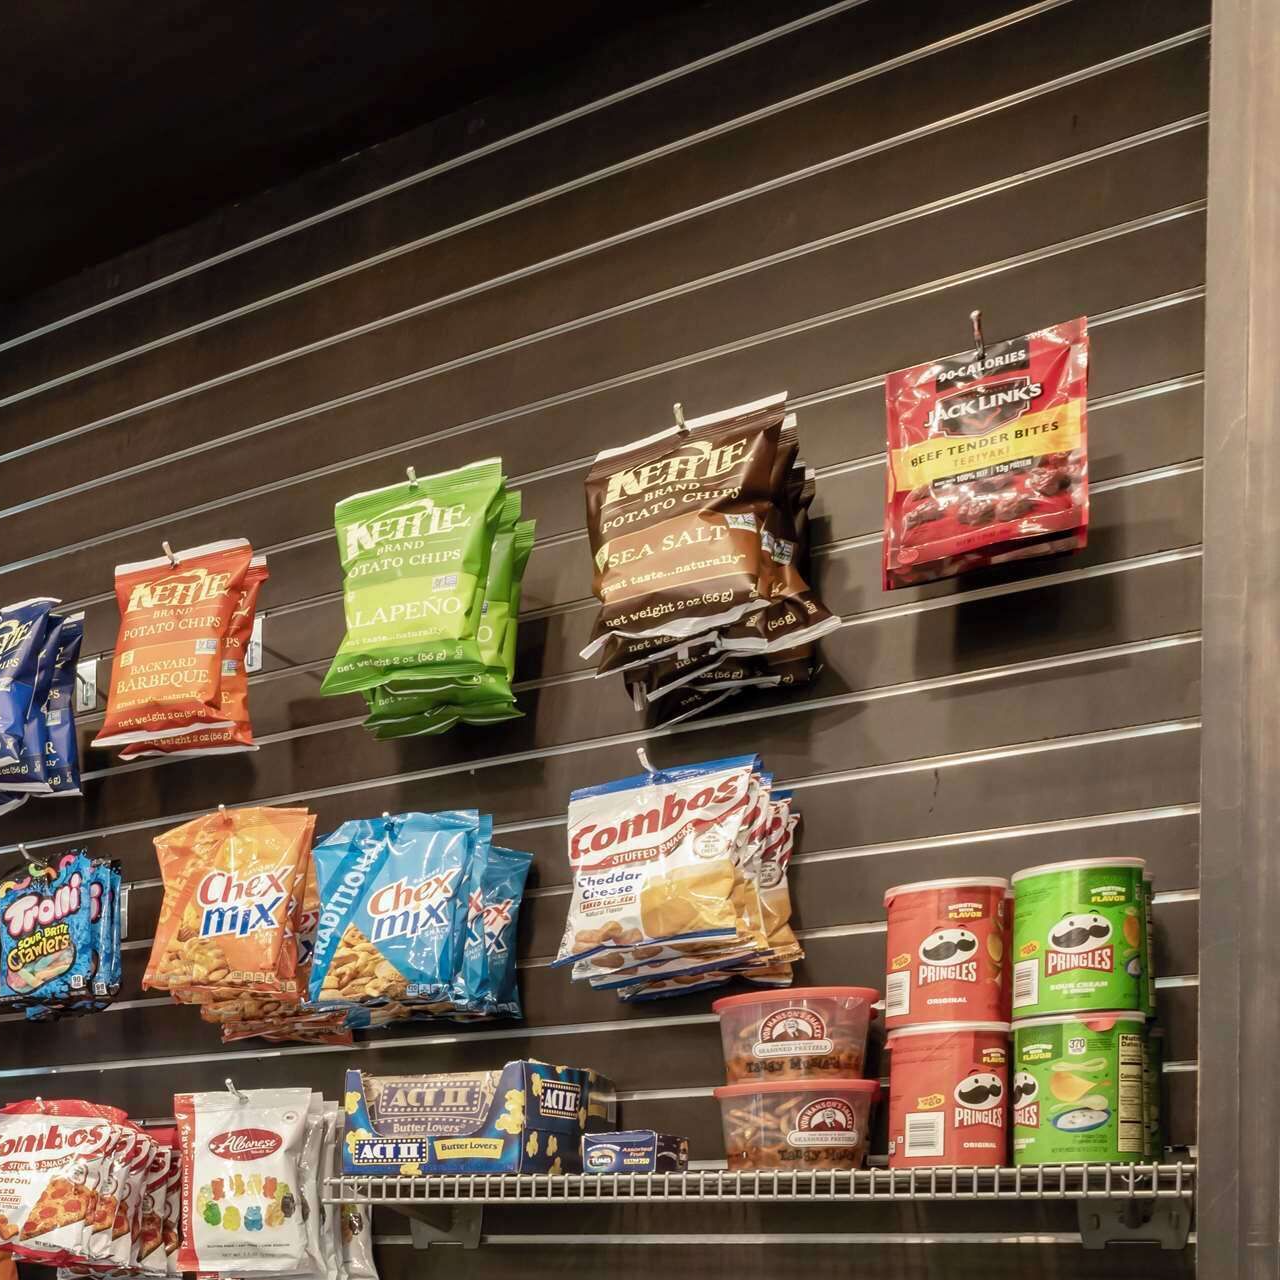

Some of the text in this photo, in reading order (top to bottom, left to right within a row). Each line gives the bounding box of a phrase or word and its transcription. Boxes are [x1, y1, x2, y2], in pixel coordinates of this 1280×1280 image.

[925, 382, 1042, 428] JACK LINK'S
[911, 421, 1059, 467] BEEF TENDER BITES
[953, 447, 1010, 467] TERIYAKI
[604, 439, 753, 506] KETTLE
[644, 481, 700, 502] BRAND
[602, 486, 742, 534] POTATO CHIPS
[343, 499, 470, 564] KETTLE
[378, 540, 424, 555] BRAND
[410, 549, 461, 567] CHIPS
[608, 525, 728, 568] SEA SALT
[127, 568, 232, 612] KETTLE
[153, 608, 193, 618] BRAND
[606, 599, 701, 628] net weight 2 oz
[124, 616, 221, 640] POTATO CHIPS
[131, 656, 197, 675] BACKYARD
[337, 656, 414, 672] net weight 2 oz
[119, 711, 165, 728] net weight
[570, 774, 750, 860] Combos
[612, 825, 694, 866] STUFFED SNACKS
[198, 866, 293, 906] Chex
[578, 872, 642, 888] Cheddar
[4, 872, 81, 936] Trolli
[368, 868, 461, 917] Chex
[201, 896, 282, 936] mix
[373, 901, 448, 943] mix
[18, 924, 68, 950] SOUR BRITE
[8, 934, 69, 972] Crawlers
[1048, 950, 1112, 974] PRINGLES
[918, 962, 977, 986] PRINGLES
[927, 997, 967, 1005] ORIGINAL
[1068, 1039, 1085, 1049] 370
[389, 1088, 436, 1108] ACT
[544, 1091, 564, 1110] ACT
[393, 1122, 426, 1134] Butter
[954, 1108, 1002, 1128] PRINGLES
[219, 1136, 277, 1152] Albanese
[360, 1142, 393, 1159] ACT
[441, 1140, 498, 1152] Butter Lovers
